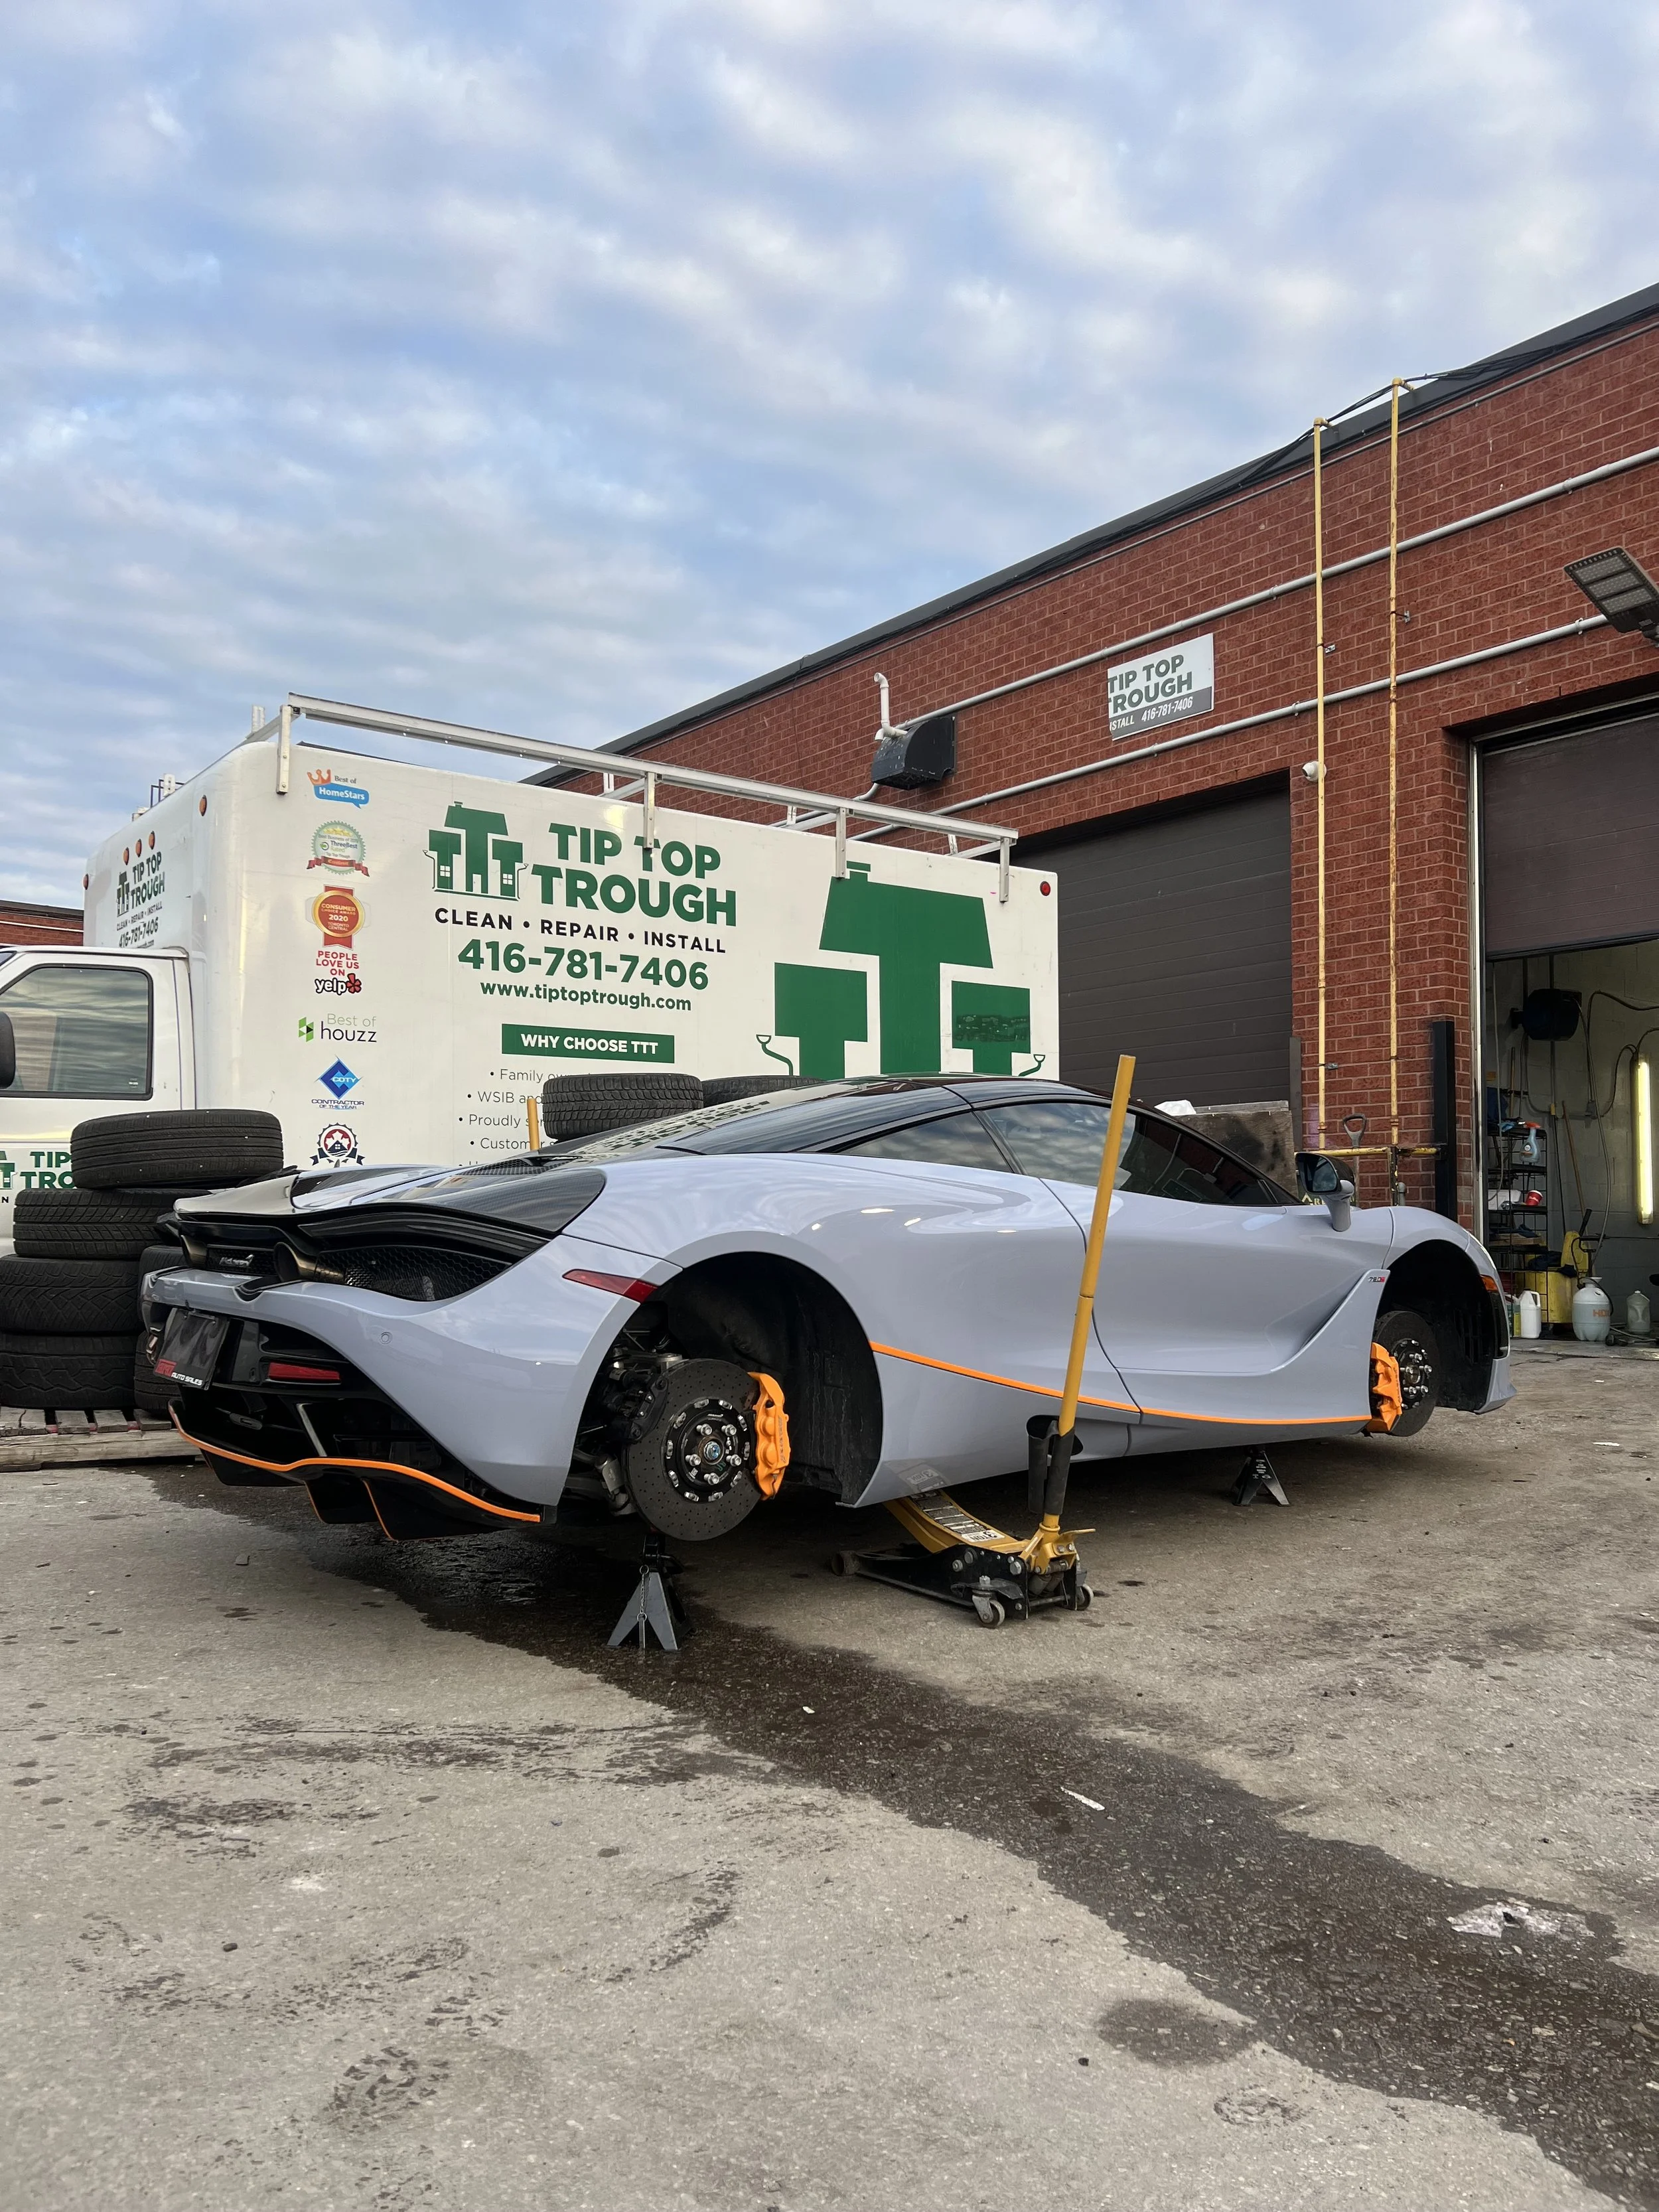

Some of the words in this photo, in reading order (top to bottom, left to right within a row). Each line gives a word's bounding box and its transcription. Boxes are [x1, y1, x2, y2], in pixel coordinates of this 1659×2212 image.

[1108, 670, 1137, 694] TIP
[1143, 654, 1184, 682] TOP
[1109, 671, 1192, 714] ROUGH
[1141, 696, 1193, 721] 416-781-7406
[319, 786, 366, 800] HomeStars
[330, 840, 358, 849] ThreeBest
[549, 822, 622, 865] TIP
[634, 835, 721, 879] TOP
[132, 861, 145, 885] TIP
[146, 851, 162, 877] TOP
[131, 871, 165, 910] TROUGH
[531, 863, 737, 926] TROUGH
[321, 903, 356, 912] CONSUMER
[119, 917, 159, 948] 416-781-7406
[435, 907, 512, 930] CLEAN
[540, 919, 619, 942] REPAIR
[644, 930, 726, 954] INSTALL
[316, 958, 343, 968] LOVE
[346, 961, 360, 970] US
[318, 950, 358, 961] PEOPLE
[458, 938, 709, 990] 416-781-7406
[315, 977, 347, 995] yelp
[480, 982, 691, 1011] www.tiptoptrough.com
[327, 1013, 358, 1027] Best
[362, 1016, 377, 1027] of
[321, 1021, 377, 1043] houzz
[521, 1033, 560, 1049] WHY
[563, 1036, 628, 1053] CHOOSE
[631, 1040, 658, 1055] TTT
[500, 1069, 543, 1084] Family
[477, 1091, 515, 1104] WSIB
[469, 1114, 521, 1128] Proudly
[480, 1138, 545, 1149] Customr
[30, 1151, 72, 1168] TIP
[171, 1372, 186, 1381] AUTO
[184, 1376, 203, 1386] SALES
